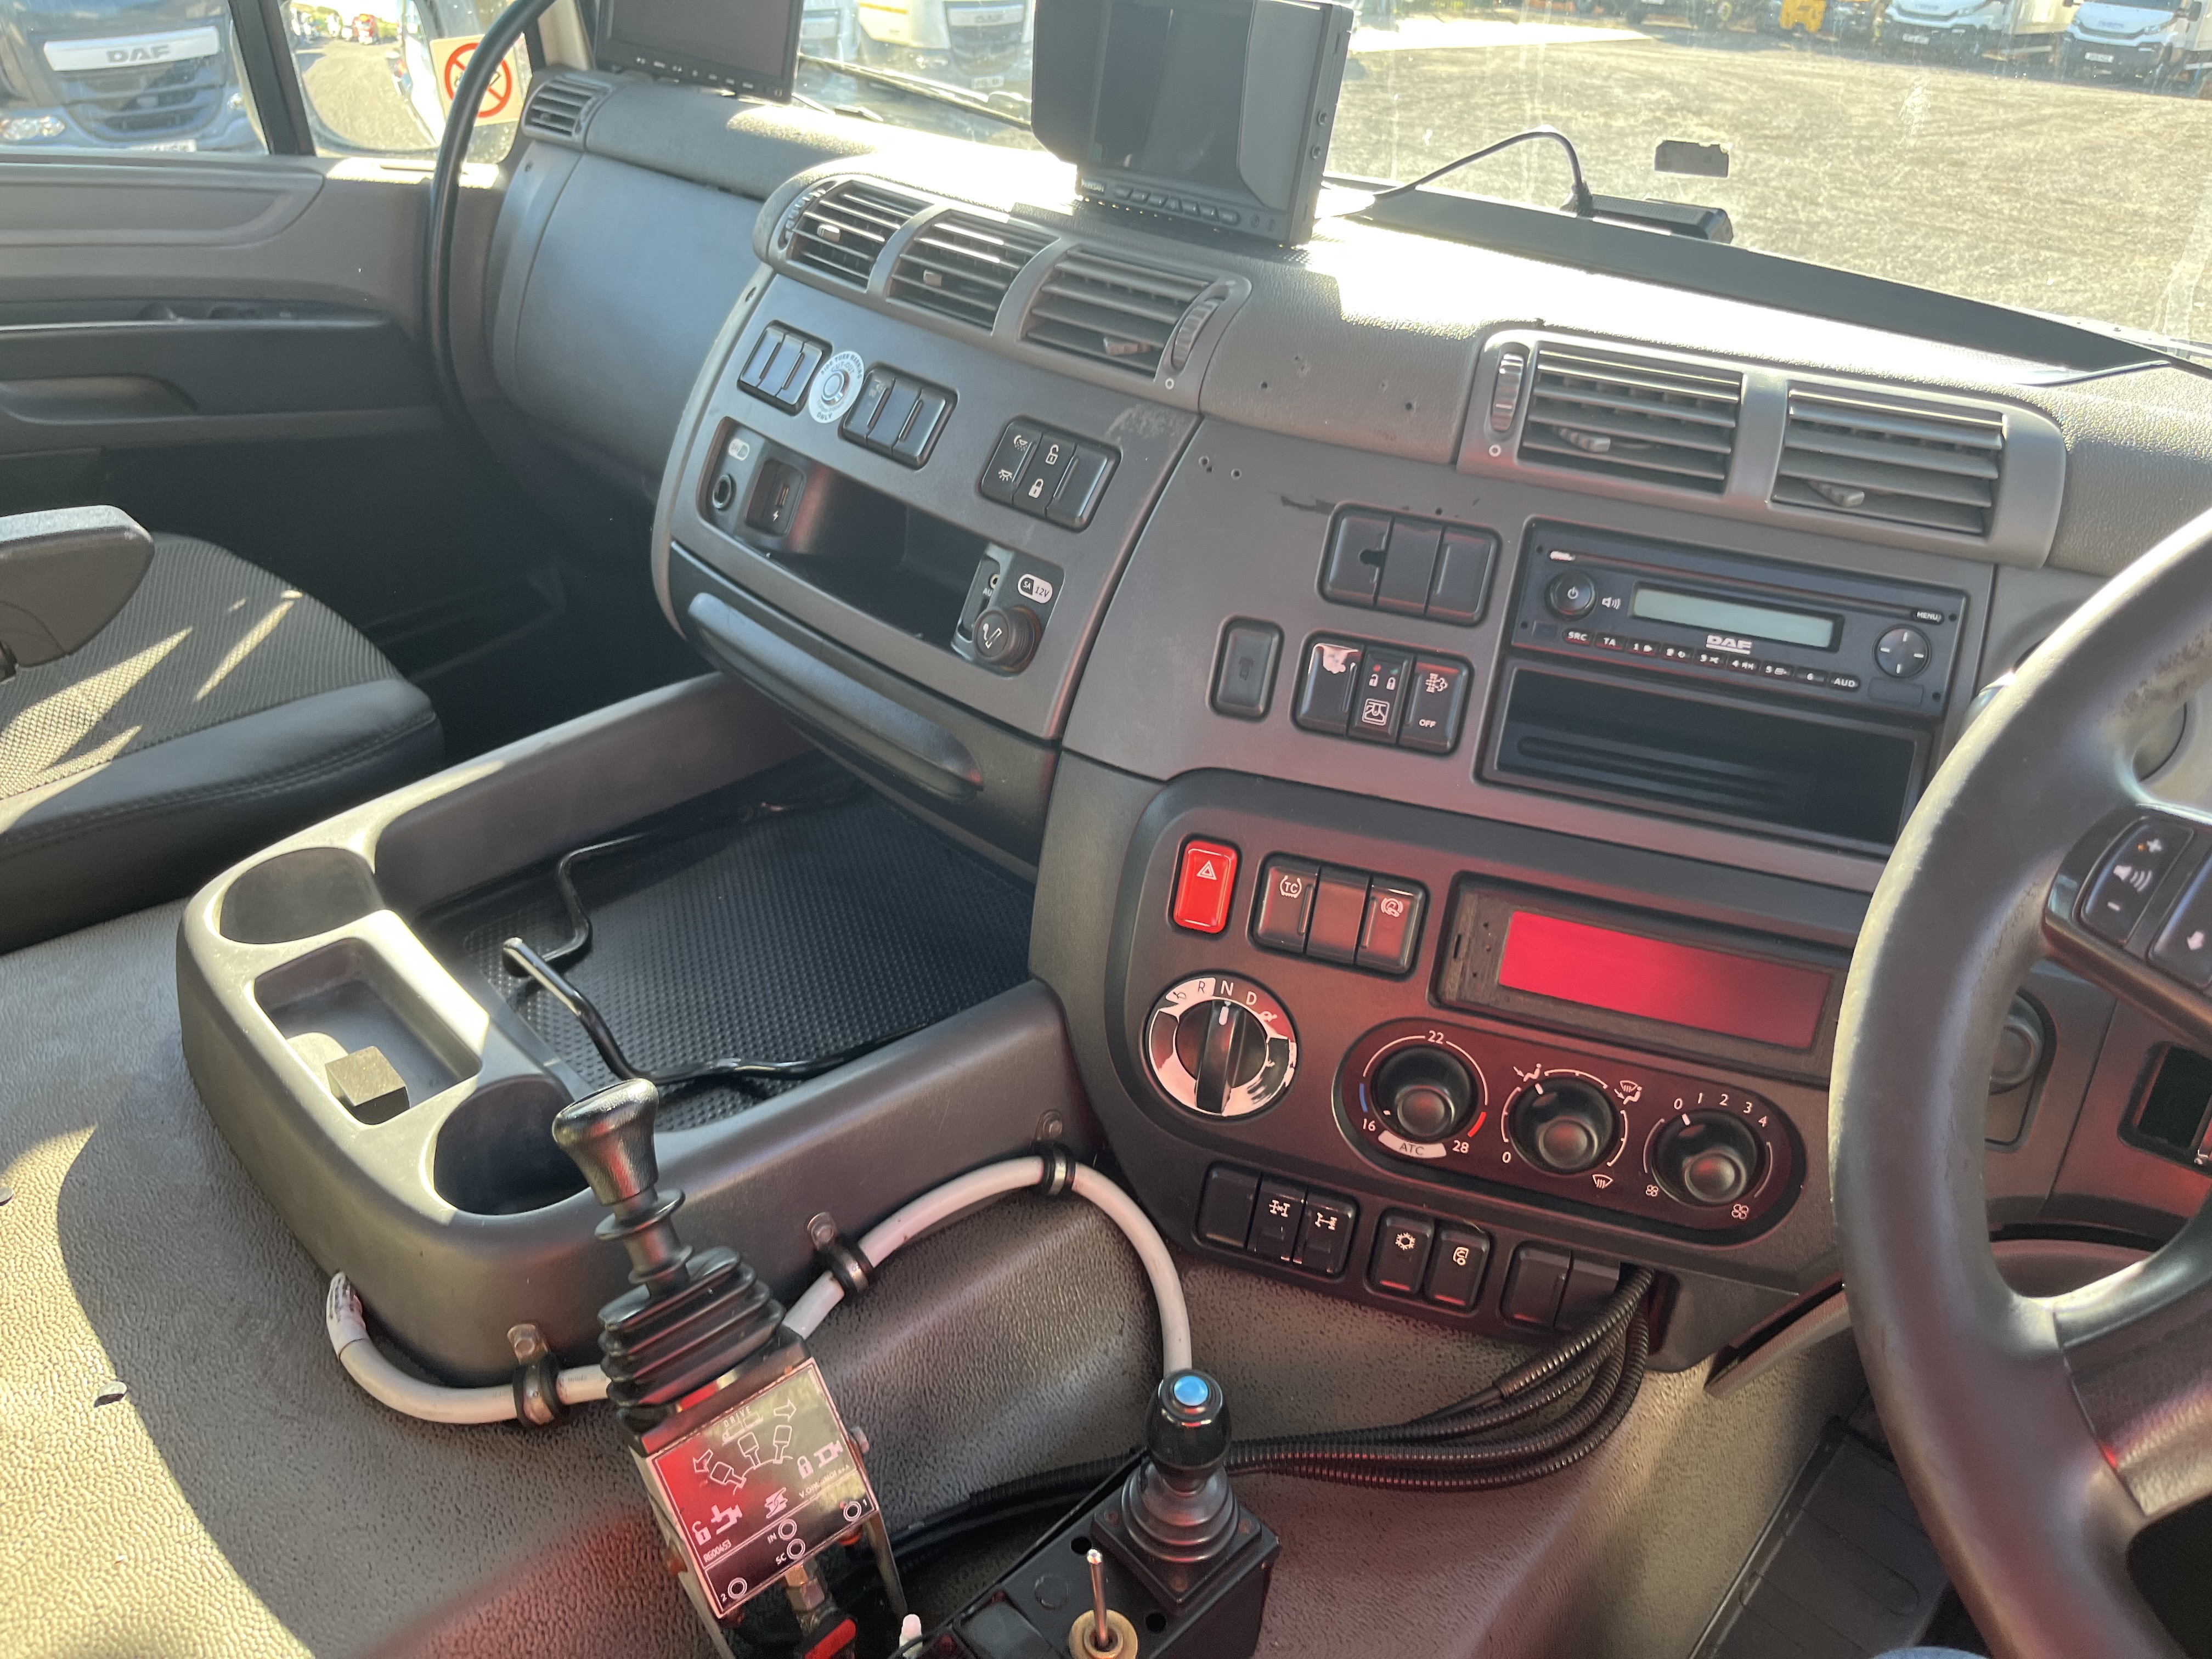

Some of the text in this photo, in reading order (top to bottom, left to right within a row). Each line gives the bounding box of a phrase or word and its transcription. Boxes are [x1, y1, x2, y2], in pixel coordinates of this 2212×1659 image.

[106, 44, 170, 63] DAF
[821, 353, 862, 379] SIDE TURN WARNING
[831, 362, 855, 374] CUT-OUT
[816, 412, 832, 420] ONLY
[982, 587, 993, 597] AU
[1035, 586, 1049, 597] 12V
[1916, 611, 1938, 620] MENU
[1567, 631, 1588, 641] SRC
[1603, 637, 1616, 646] TA
[1706, 634, 1753, 650] DAF
[1732, 659, 1739, 668] 4
[1807, 673, 1814, 681] 6
[1833, 678, 1856, 688] AUD
[1419, 719, 1436, 728] OFF
[1284, 881, 1299, 894] TC
[1198, 980, 1257, 1006] R N D
[1426, 1030, 1444, 1045] 22
[1673, 1092, 1768, 1128] 0 1 2 3 4
[1362, 1117, 1376, 1132] 16
[1399, 1142, 1425, 1156] ATC
[1452, 1139, 1469, 1154] 28
[1502, 1152, 1511, 1164] 0
[723, 1405, 752, 1428] DRIVE
[862, 1498, 868, 1508] 1
[767, 1532, 777, 1544] IN
[703, 1538, 732, 1563] RG00453
[775, 1551, 787, 1565] SC
[720, 1593, 727, 1602] 2
